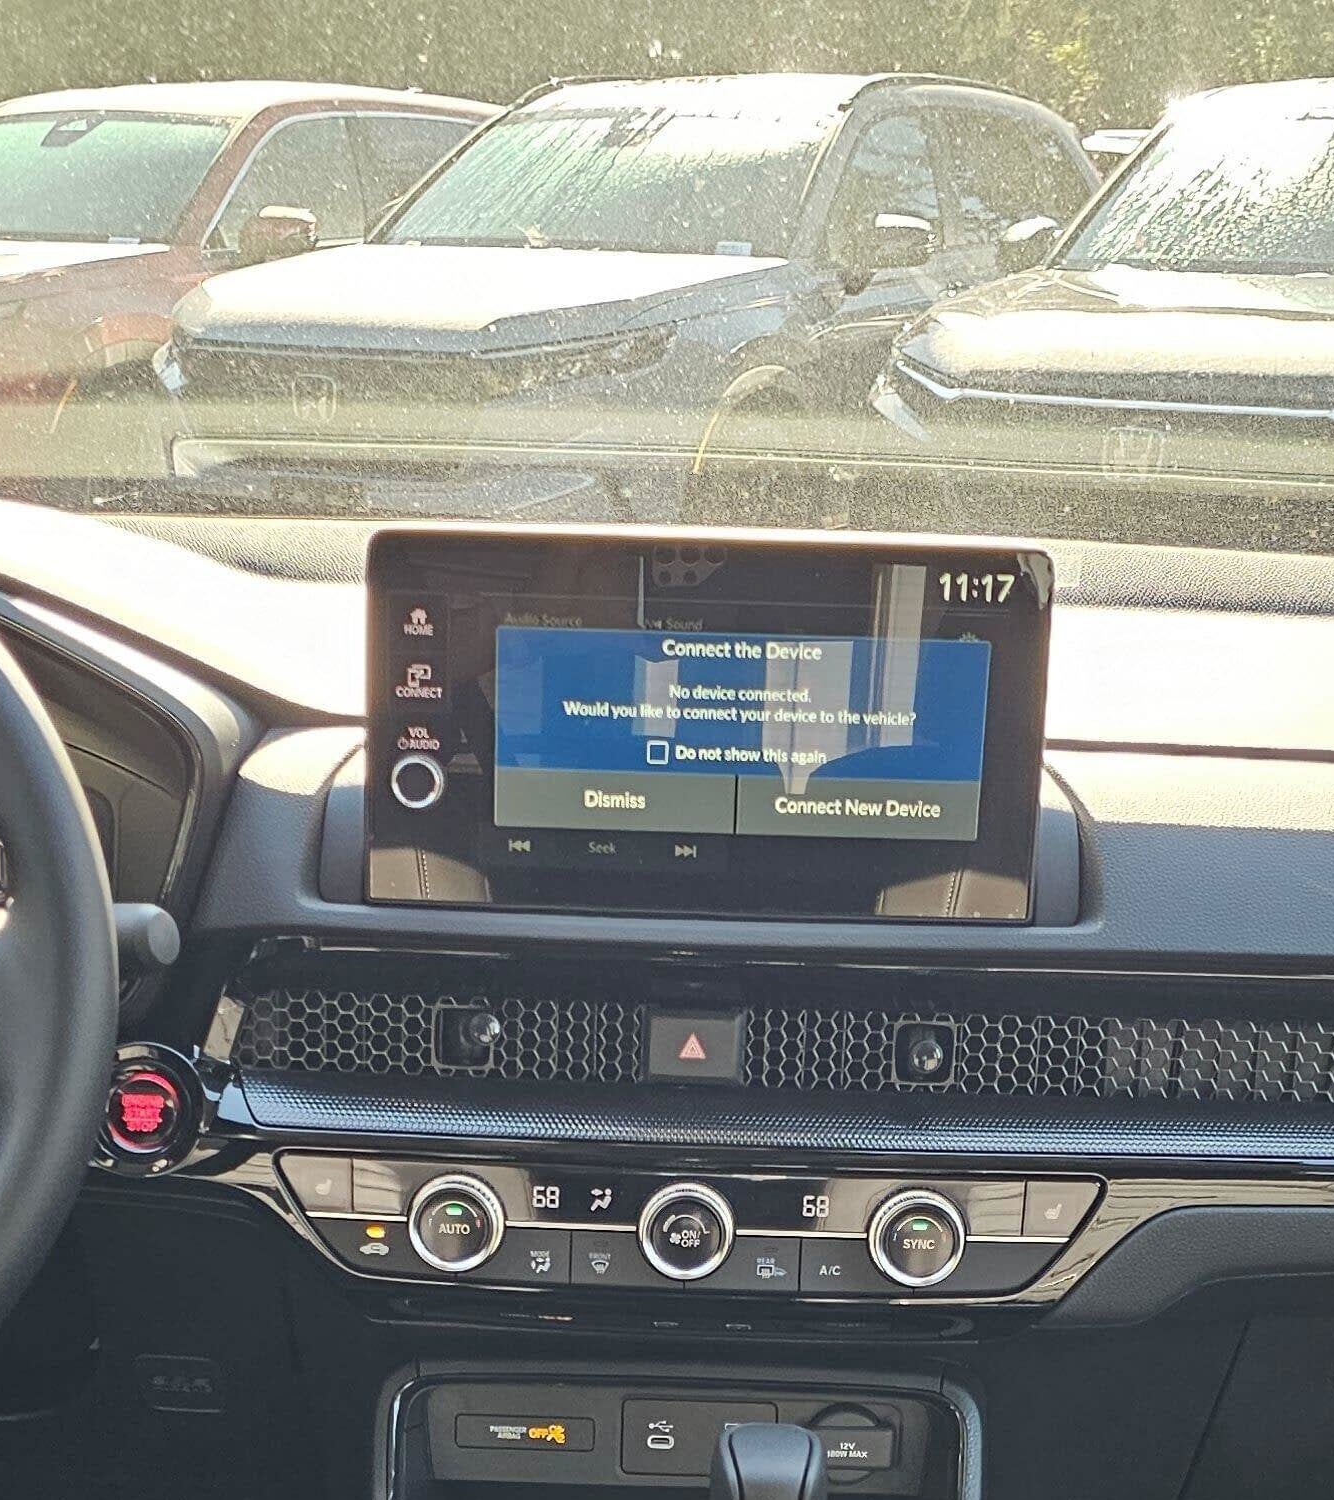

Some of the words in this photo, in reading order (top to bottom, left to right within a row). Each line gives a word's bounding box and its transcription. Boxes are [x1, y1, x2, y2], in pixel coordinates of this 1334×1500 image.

[939, 572, 1015, 603] 11:17
[403, 624, 434, 636] HOME
[662, 639, 731, 659] Connect
[734, 641, 762, 659] the
[766, 641, 823, 661] Device
[396, 686, 443, 699] CONNECT
[669, 684, 687, 699] No
[692, 685, 736, 700] device
[738, 687, 811, 703] connected.
[562, 700, 609, 717] Would
[611, 705, 637, 721] you
[640, 704, 663, 719] like
[667, 707, 681, 720] to
[683, 706, 738, 721] connect
[740, 709, 773, 724] your
[774, 709, 817, 723] device
[820, 711, 834, 724] to
[837, 710, 860, 725] the
[863, 711, 917, 726] vehicle?
[408, 727, 429, 738] VOL
[409, 738, 440, 751] AUDIO
[675, 745, 696, 761] Do
[699, 746, 722, 761] not
[724, 746, 762, 762] show
[763, 748, 788, 763] this
[791, 750, 827, 766] again
[584, 788, 646, 810] Dismiss
[774, 796, 842, 816] Connect
[845, 798, 884, 817] New
[885, 800, 941, 818] Device
[588, 841, 617, 855] Seek
[532, 1185, 560, 1209] 68
[802, 1194, 830, 1218] 68
[438, 1222, 471, 1235] AUTO
[681, 1238, 700, 1248] OFF
[902, 1237, 935, 1251] SYNC
[588, 1252, 612, 1261] FRONT
[819, 1265, 841, 1276] A/C
[840, 1442, 856, 1450] 12V
[848, 1450, 868, 1458] MAX
